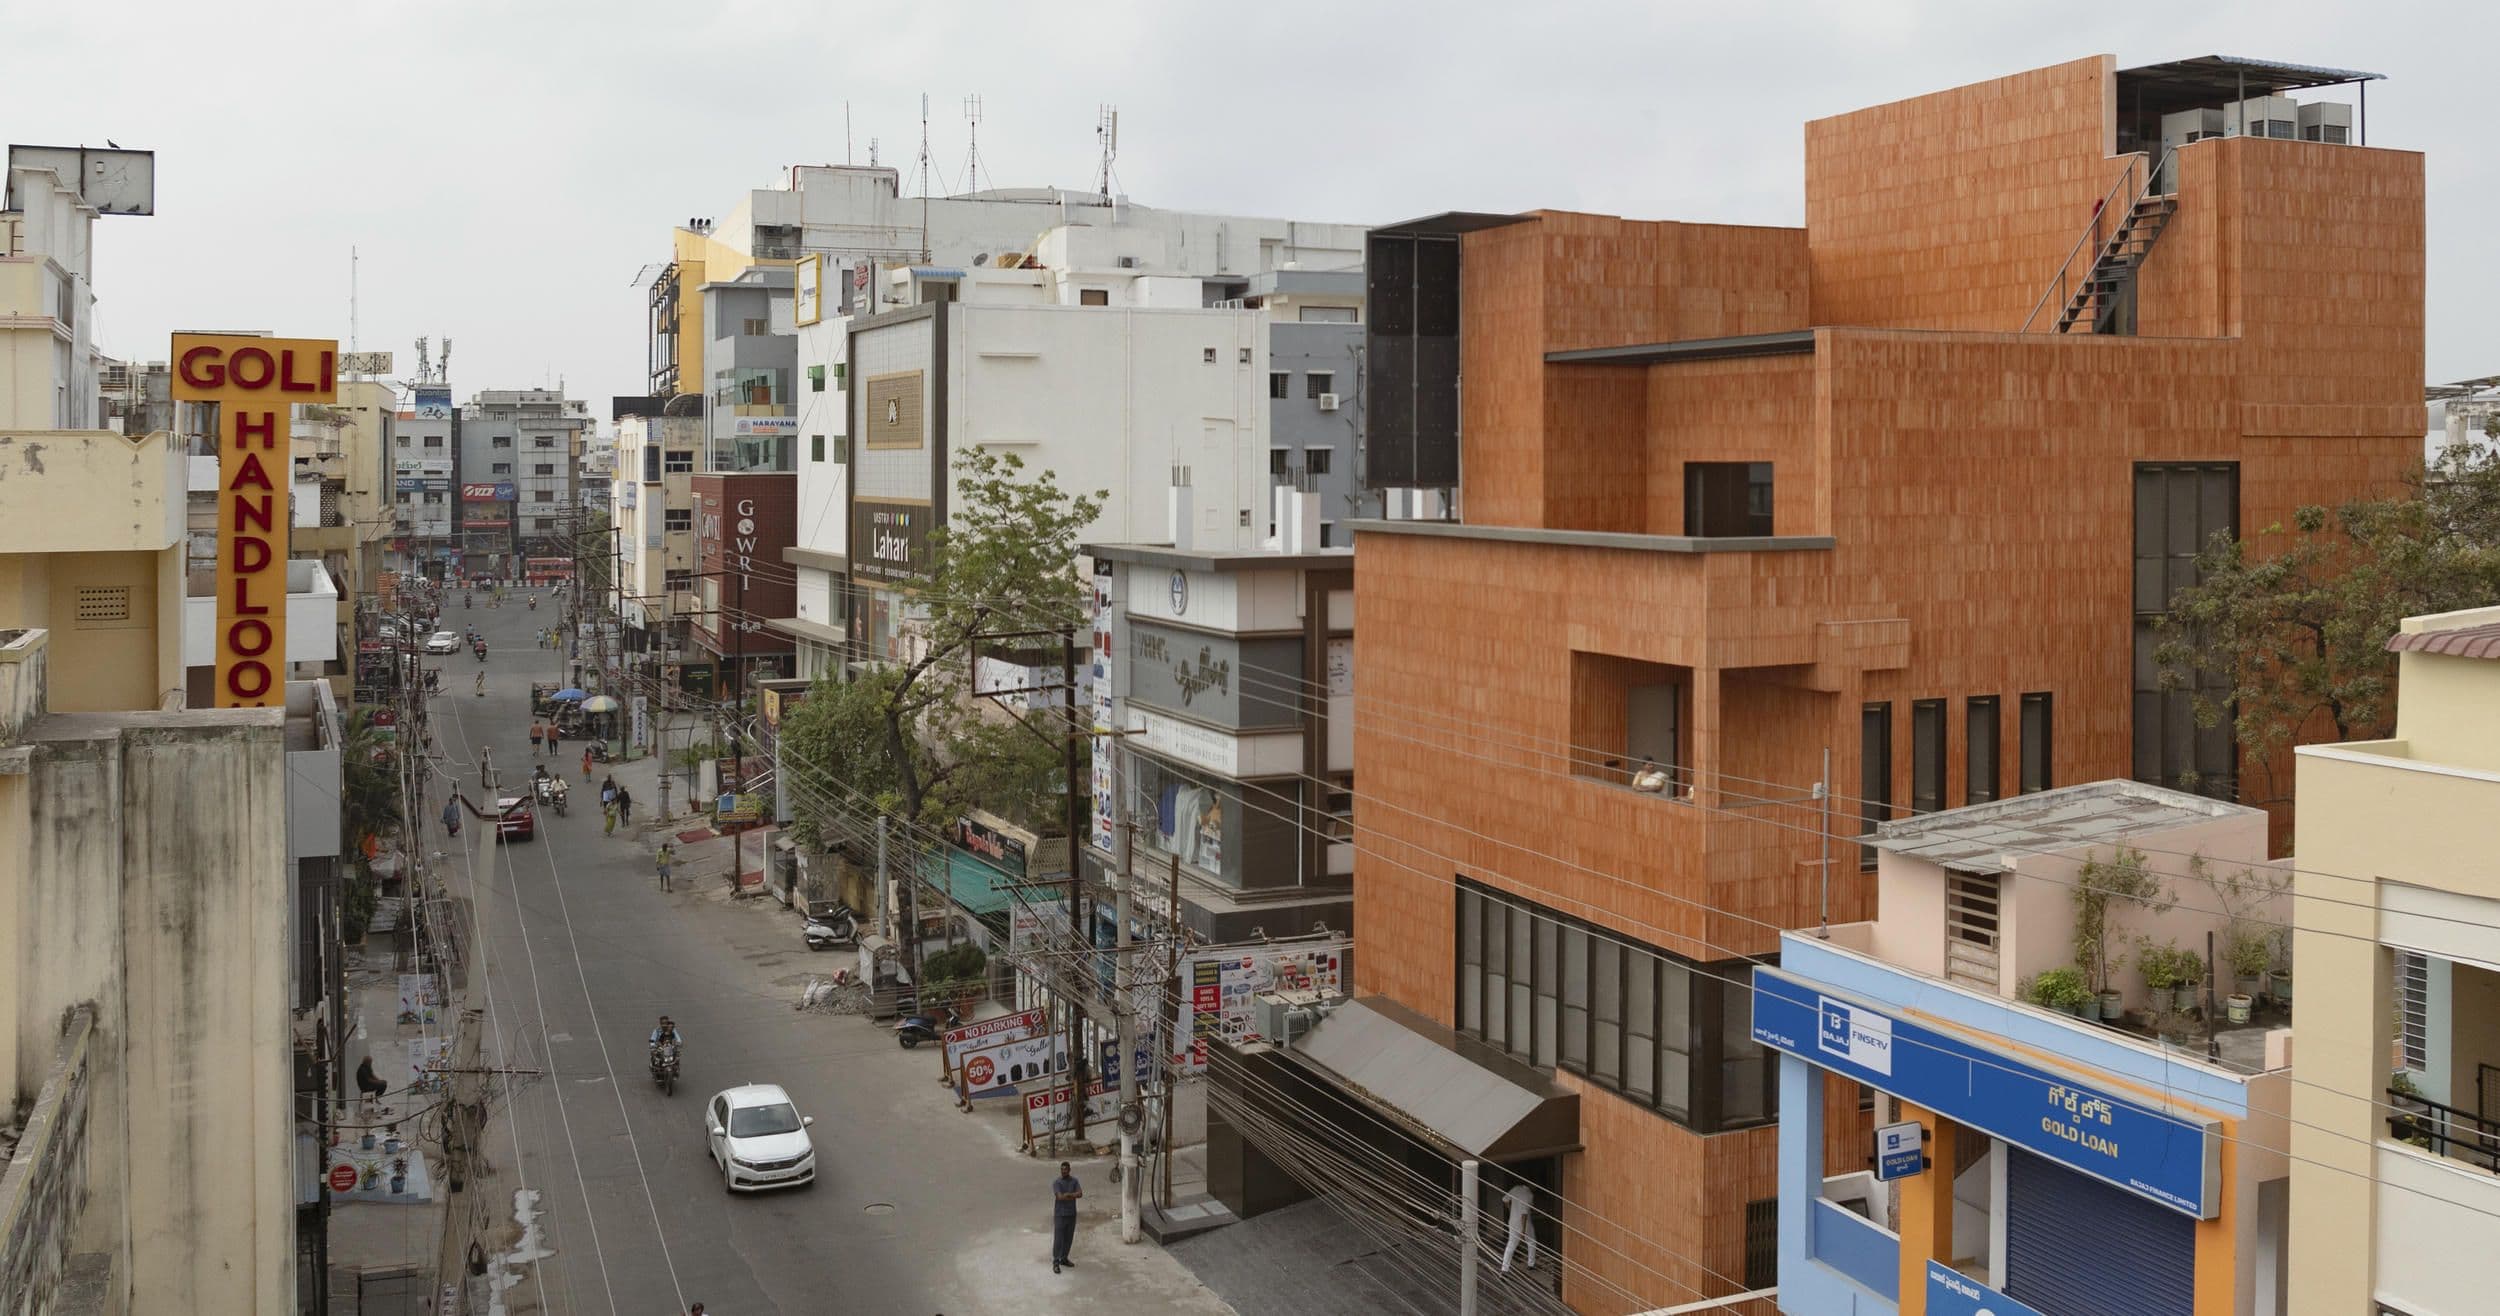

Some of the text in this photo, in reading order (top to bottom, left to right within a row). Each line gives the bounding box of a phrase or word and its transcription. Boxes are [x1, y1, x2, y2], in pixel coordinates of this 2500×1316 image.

[179, 346, 333, 393] GOLI
[752, 420, 797, 428] NARAYANA
[228, 412, 275, 707] HANDLOO
[735, 500, 758, 591] GOWRI
[873, 528, 909, 562] Lahari
[964, 1016, 1024, 1039] NO PARKING
[1823, 1030, 1849, 1047] BAJAJ
[1852, 1030, 1888, 1050] FINSERV
[968, 1065, 993, 1078] 50%
[2041, 1117, 2119, 1159] GOLD LOAN
[2129, 1178, 2198, 1210] BAJAJ FINANCE LIMITED
